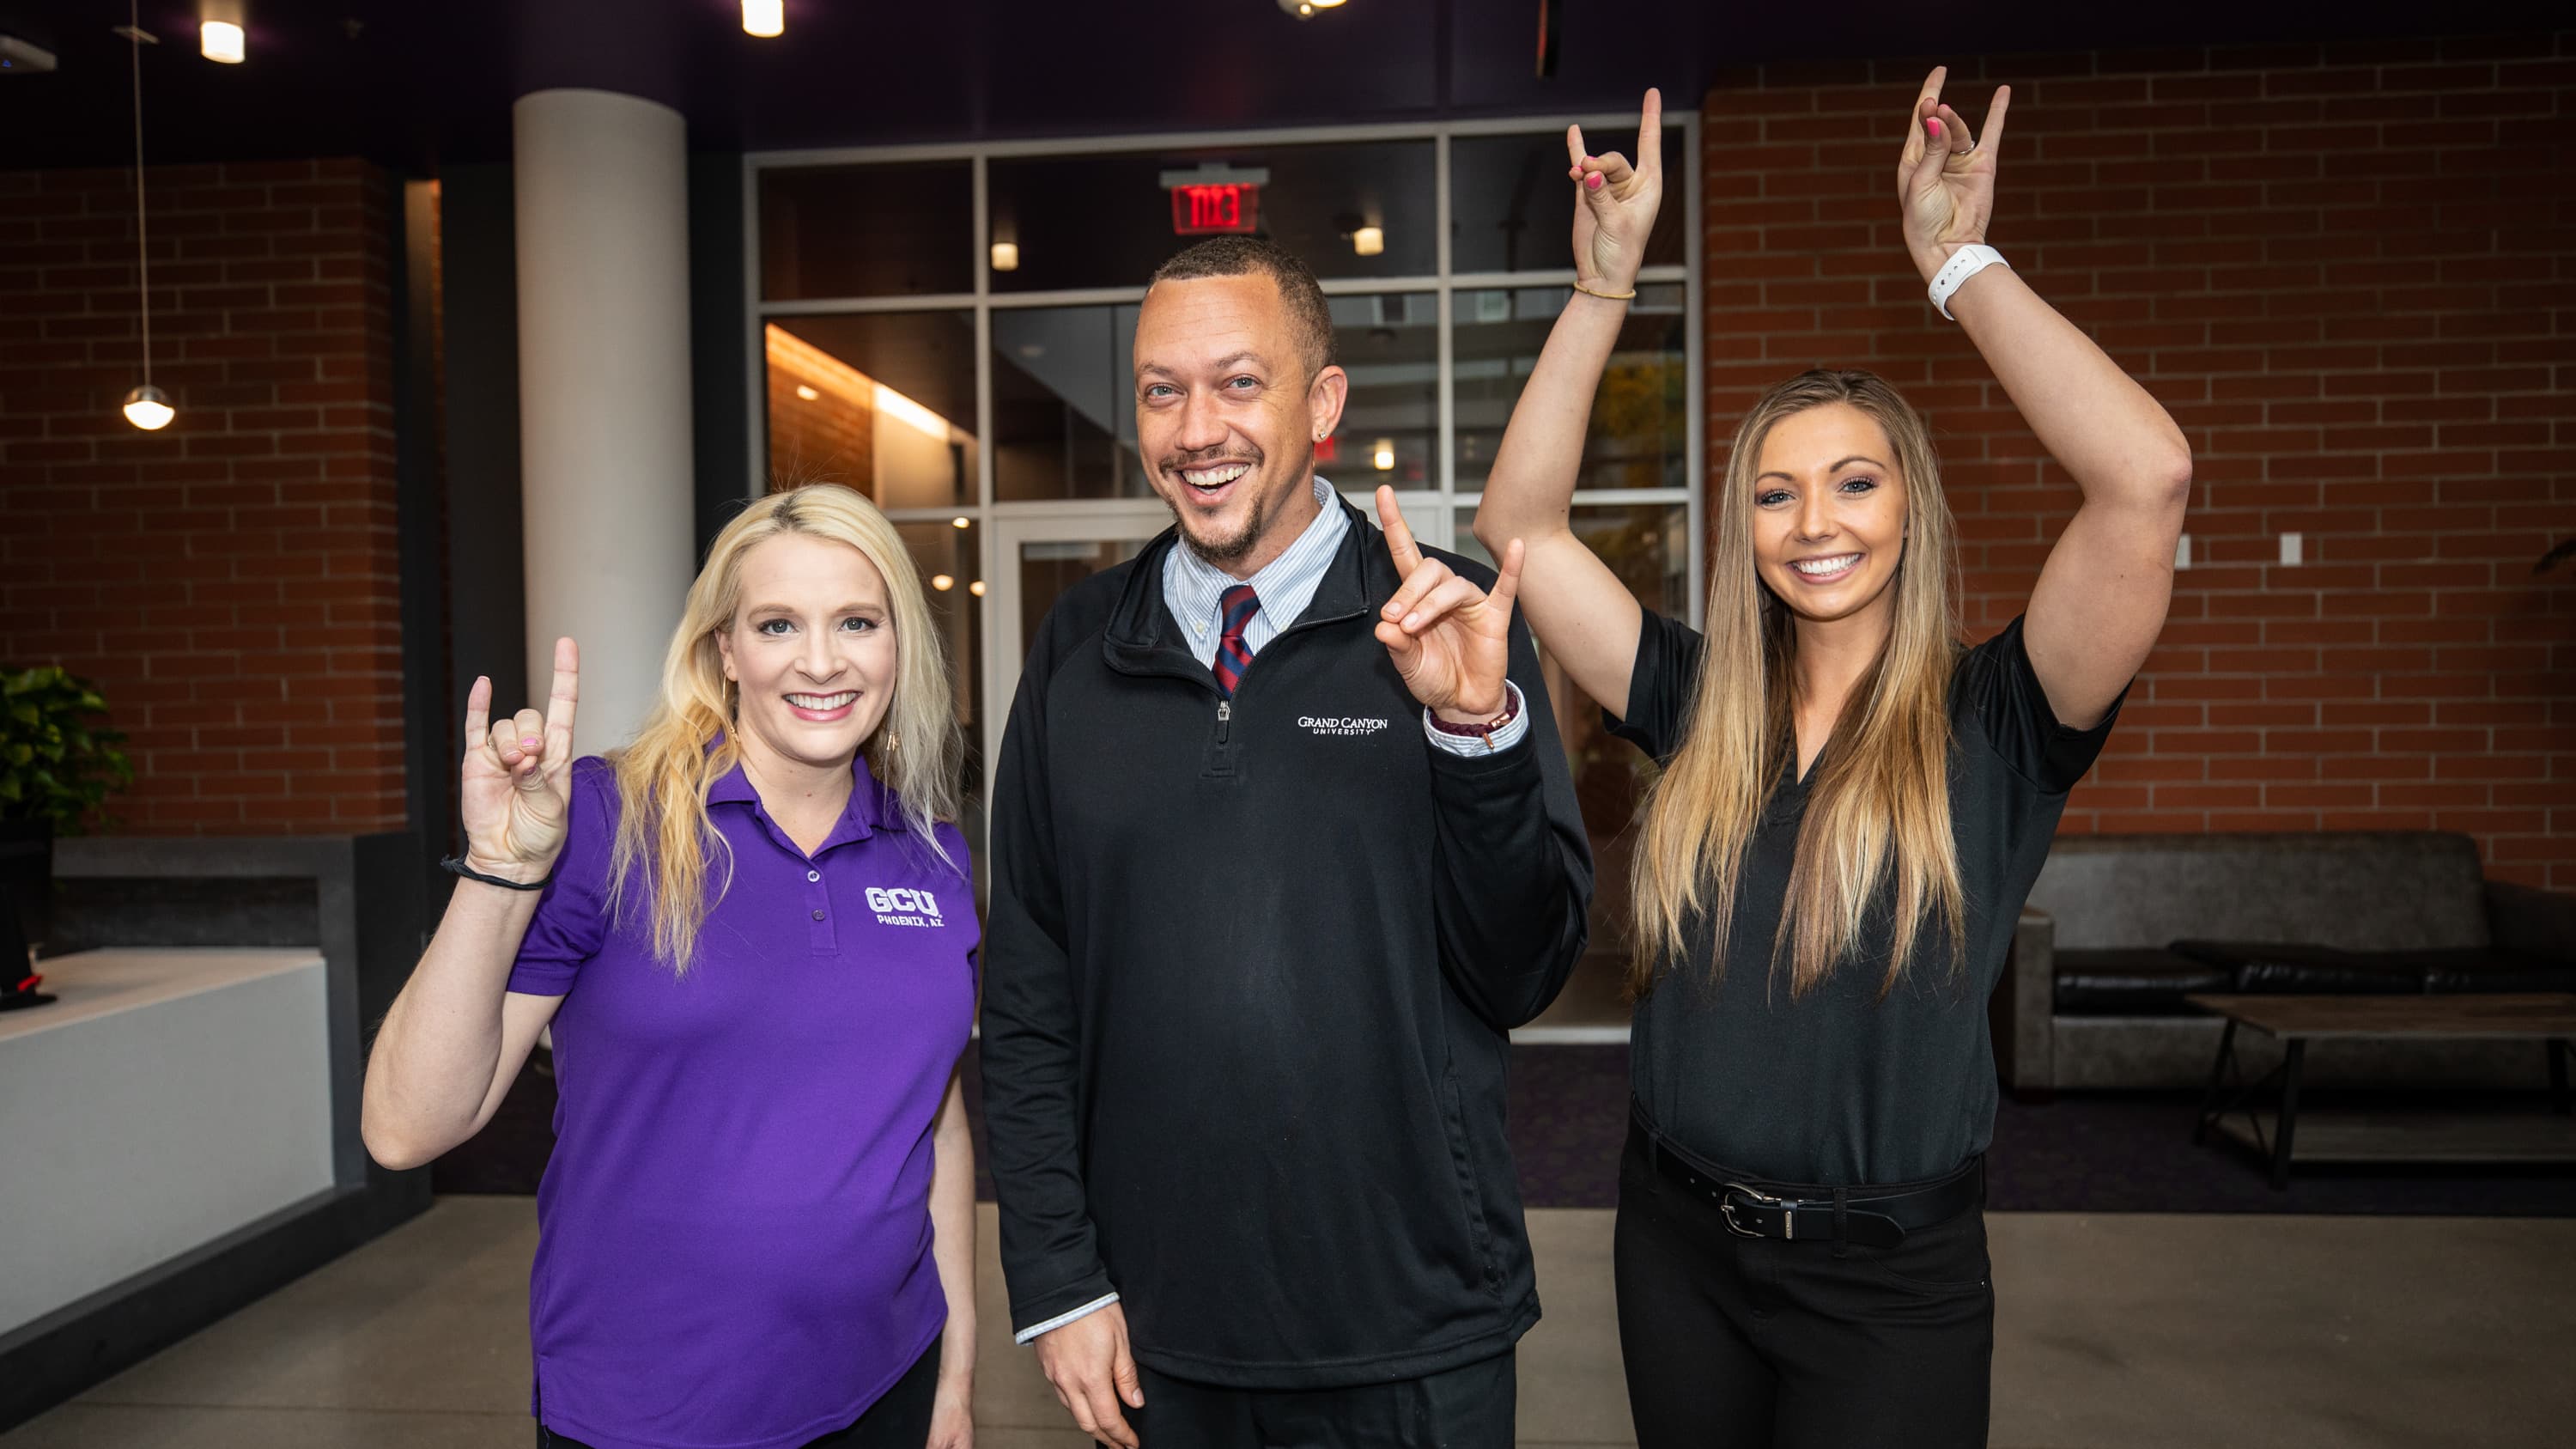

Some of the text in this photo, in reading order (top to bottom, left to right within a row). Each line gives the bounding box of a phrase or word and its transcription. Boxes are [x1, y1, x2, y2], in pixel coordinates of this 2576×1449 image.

[1297, 716, 1388, 729] GRAND CANYON
[865, 887, 939, 917] GCU
[876, 914, 945, 928] PHOENIX, AZ
